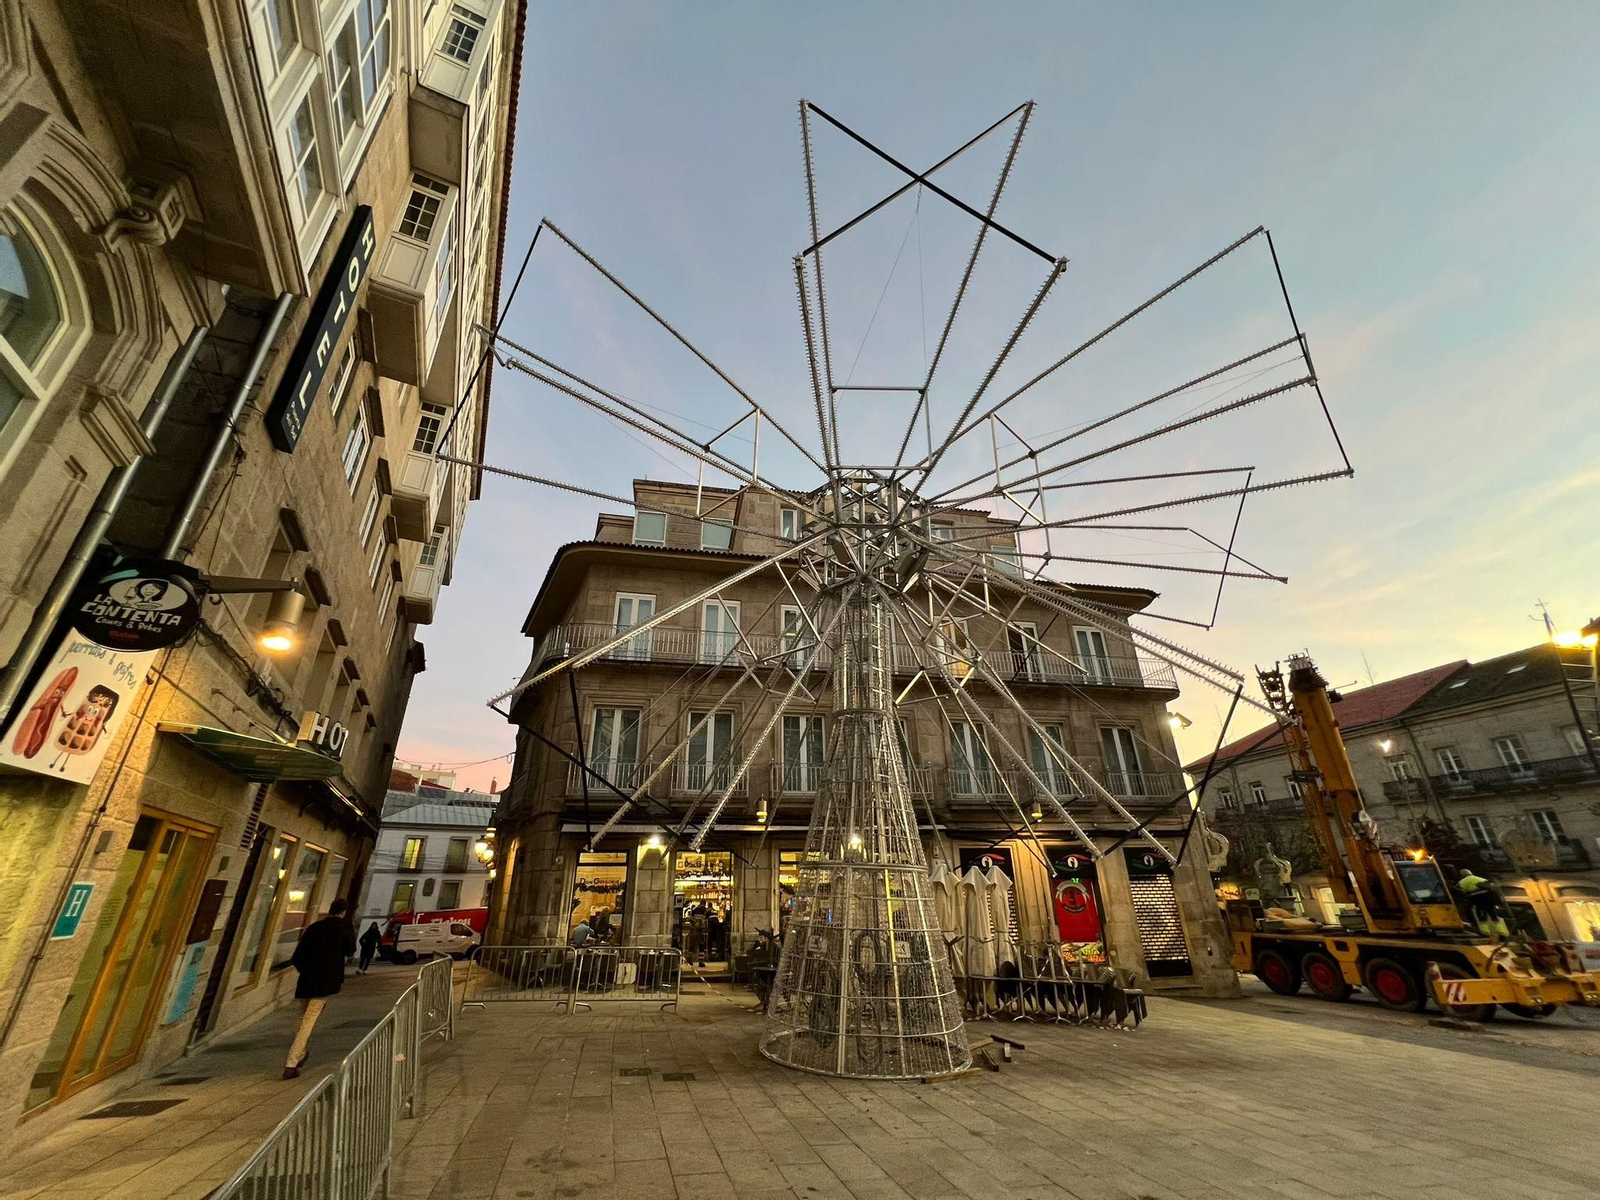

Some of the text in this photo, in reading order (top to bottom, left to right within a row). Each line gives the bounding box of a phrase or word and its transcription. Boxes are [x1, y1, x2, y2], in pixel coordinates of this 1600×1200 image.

[299, 222, 374, 410] HOTEL
[94, 594, 112, 605] LA
[81, 602, 182, 625] CONTENTA
[65, 889, 88, 917] H
